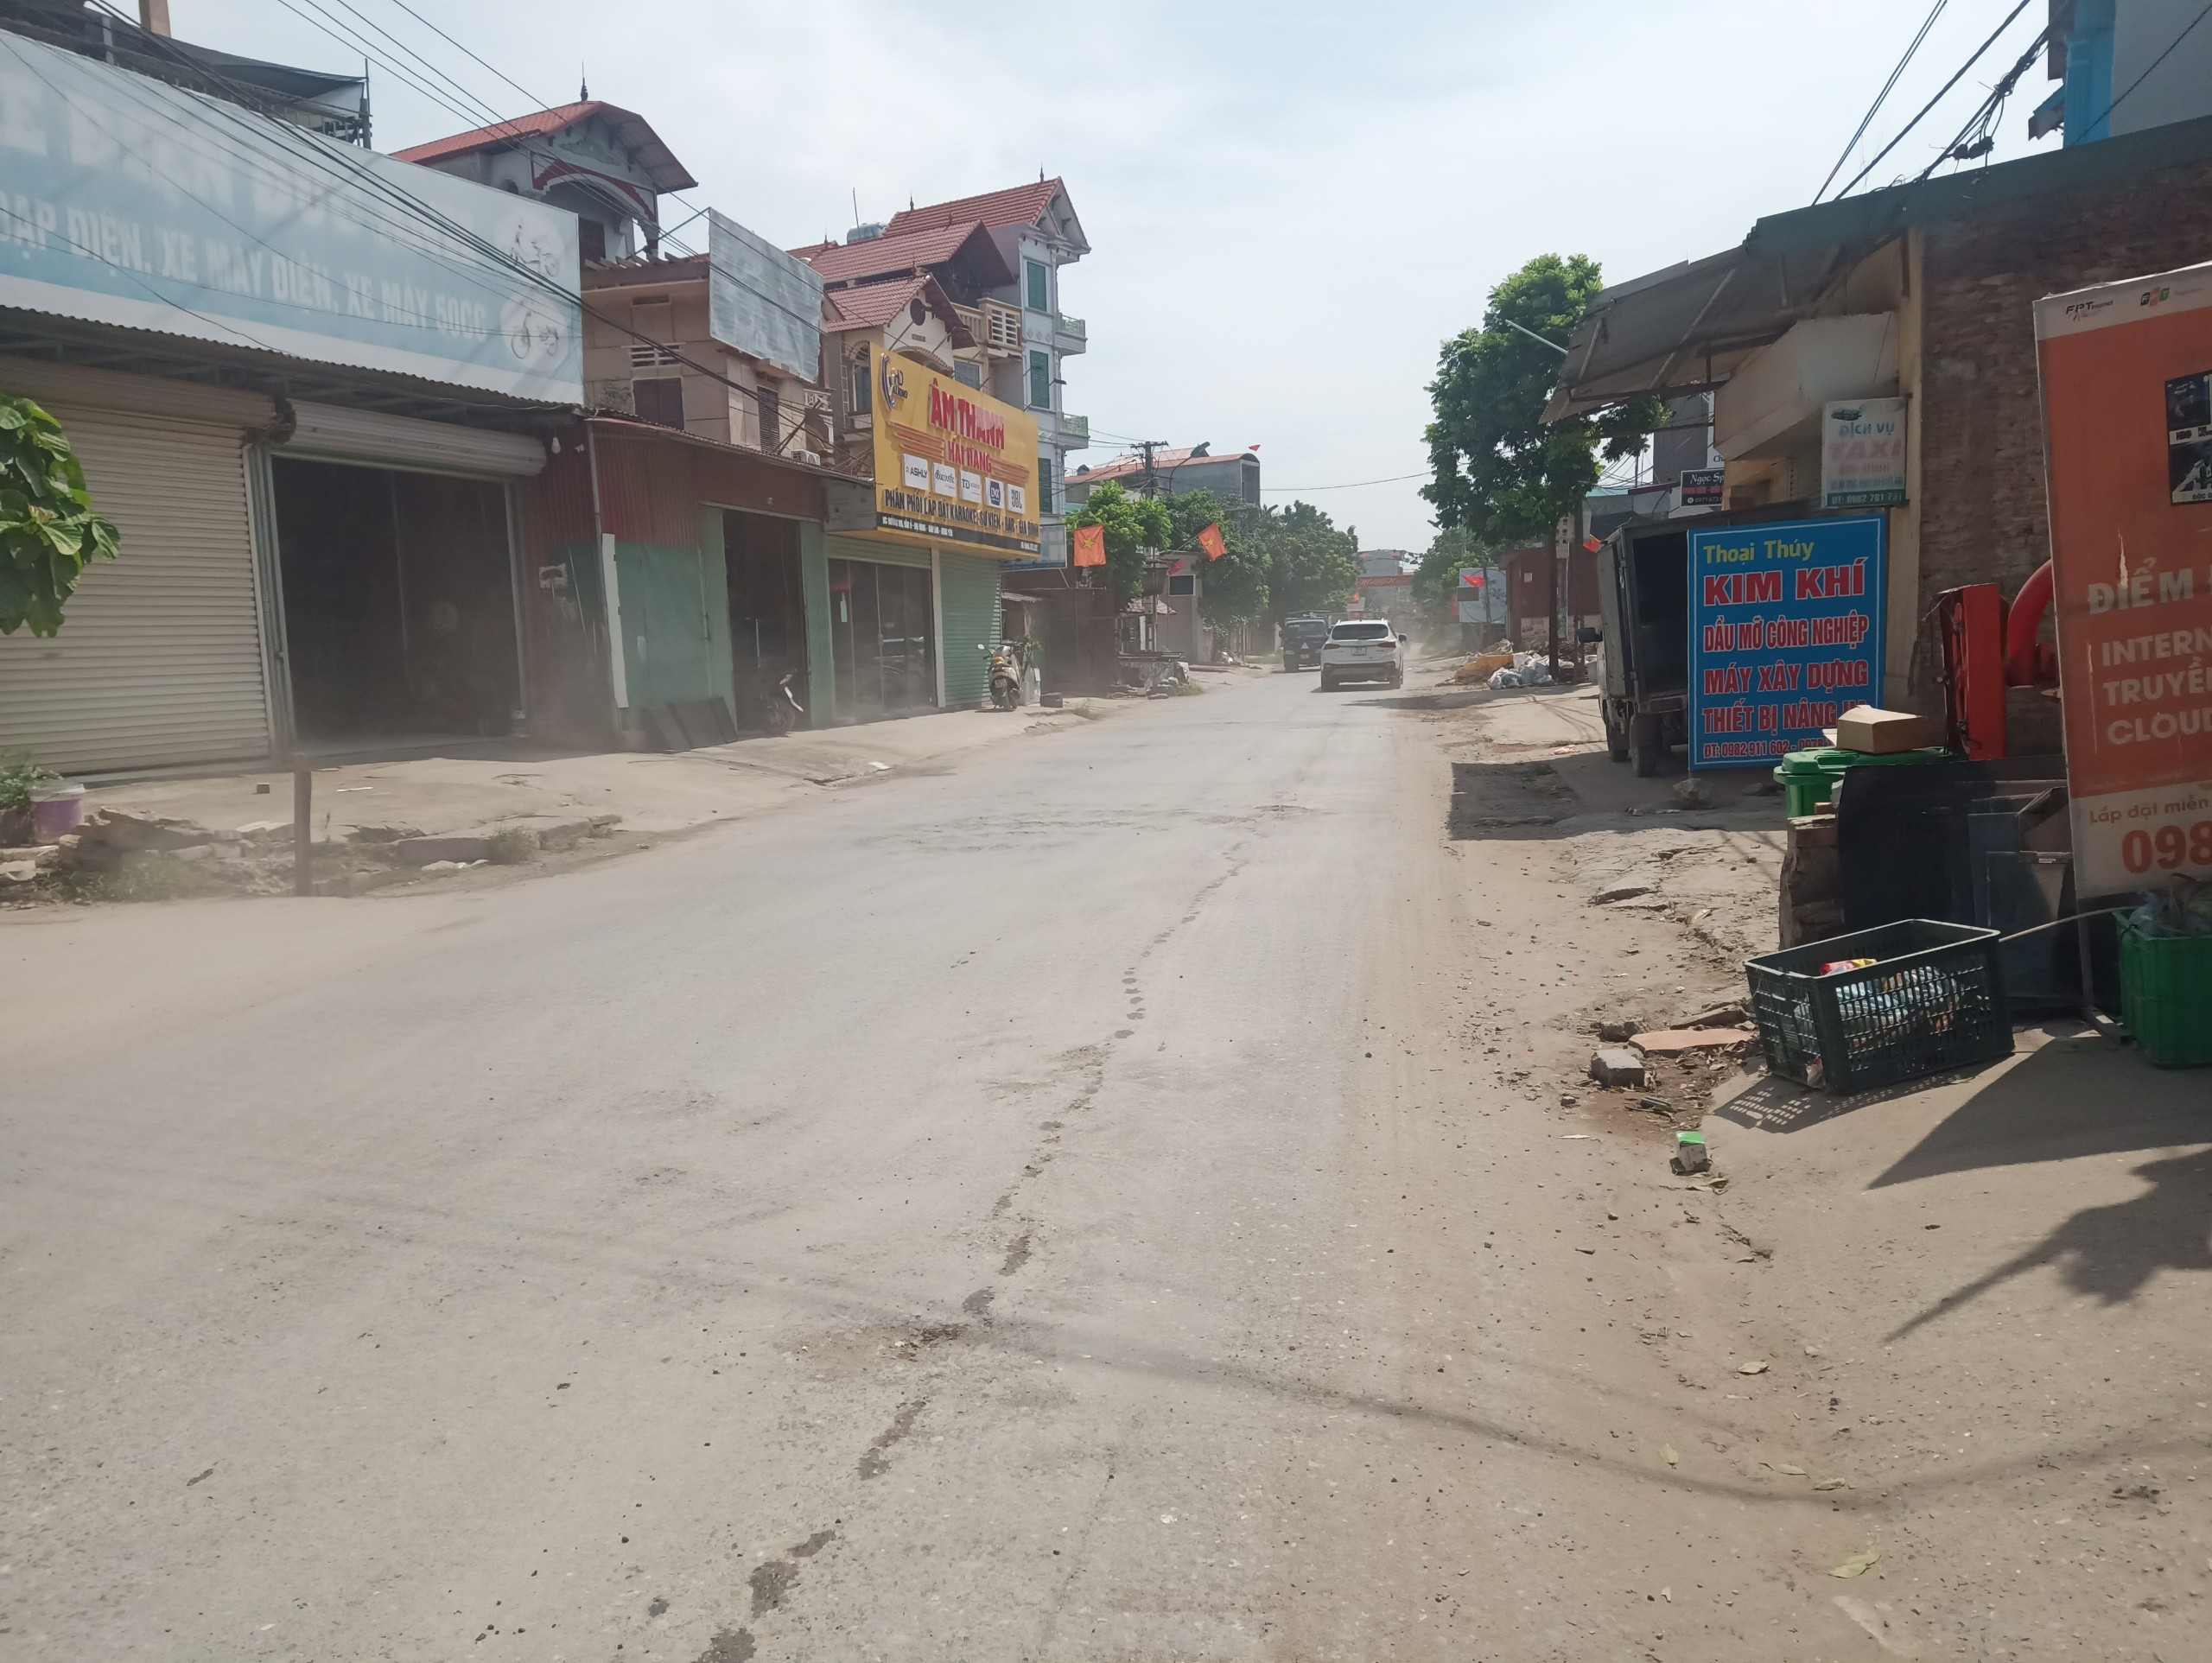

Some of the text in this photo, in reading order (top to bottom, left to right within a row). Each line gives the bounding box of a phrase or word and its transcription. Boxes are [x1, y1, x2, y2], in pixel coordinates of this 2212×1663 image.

[158, 226, 197, 283] XE
[206, 233, 264, 300] MÁY
[345, 275, 376, 316] XE
[380, 280, 430, 328] MÁY
[2065, 301, 2094, 315] FPT
[929, 377, 1005, 450] ÂM THANH
[1876, 421, 1895, 436] VỤ
[1830, 438, 1903, 461] TAXI
[1690, 473, 1711, 486] Ngọc
[885, 488, 905, 510] PHÂN
[906, 490, 922, 513] PHỐI
[950, 503, 976, 524] KARAOKE
[1703, 538, 1815, 565] Thoại Thúy
[1703, 556, 1869, 606] KIM KHÍ
[2088, 556, 2194, 614] ĐIỂM
[1703, 609, 1870, 653] DẦU MỠ CÔNG NGHIỆP
[1703, 658, 1869, 695] MÁY XÂY DỰNG
[1702, 697, 1838, 736] THIẾT BỊ NÂNG
[1703, 742, 1720, 759] ĐT:
[1720, 740, 1748, 758] 0982
[1748, 739, 1767, 757] 911
[1770, 739, 1789, 756] 602
[2090, 794, 2209, 823] Lắp đặt miễn
[2122, 821, 2212, 875] 098
